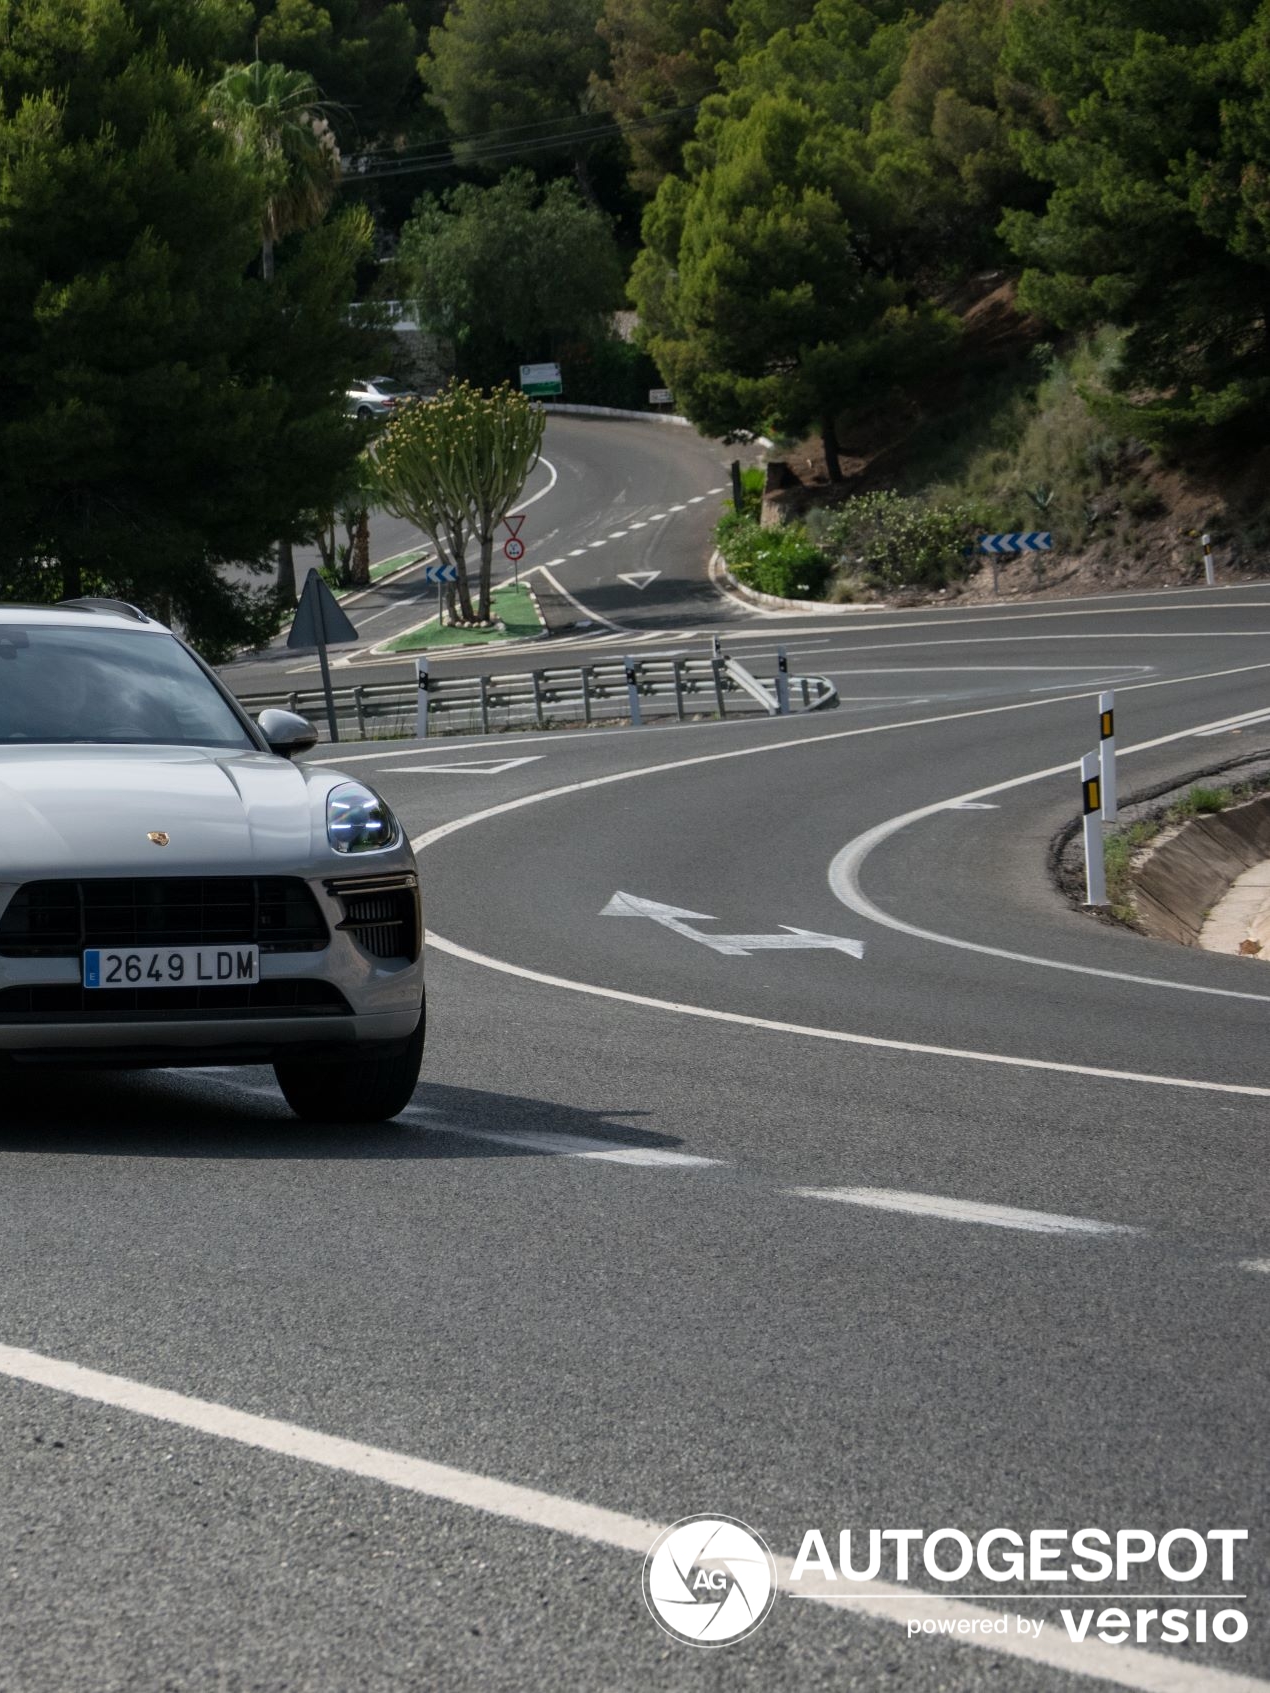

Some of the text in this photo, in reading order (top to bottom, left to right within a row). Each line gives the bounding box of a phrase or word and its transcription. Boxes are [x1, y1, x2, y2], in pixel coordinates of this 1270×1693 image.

[89, 972, 96, 981] E
[105, 951, 253, 983] 2649 LDM
